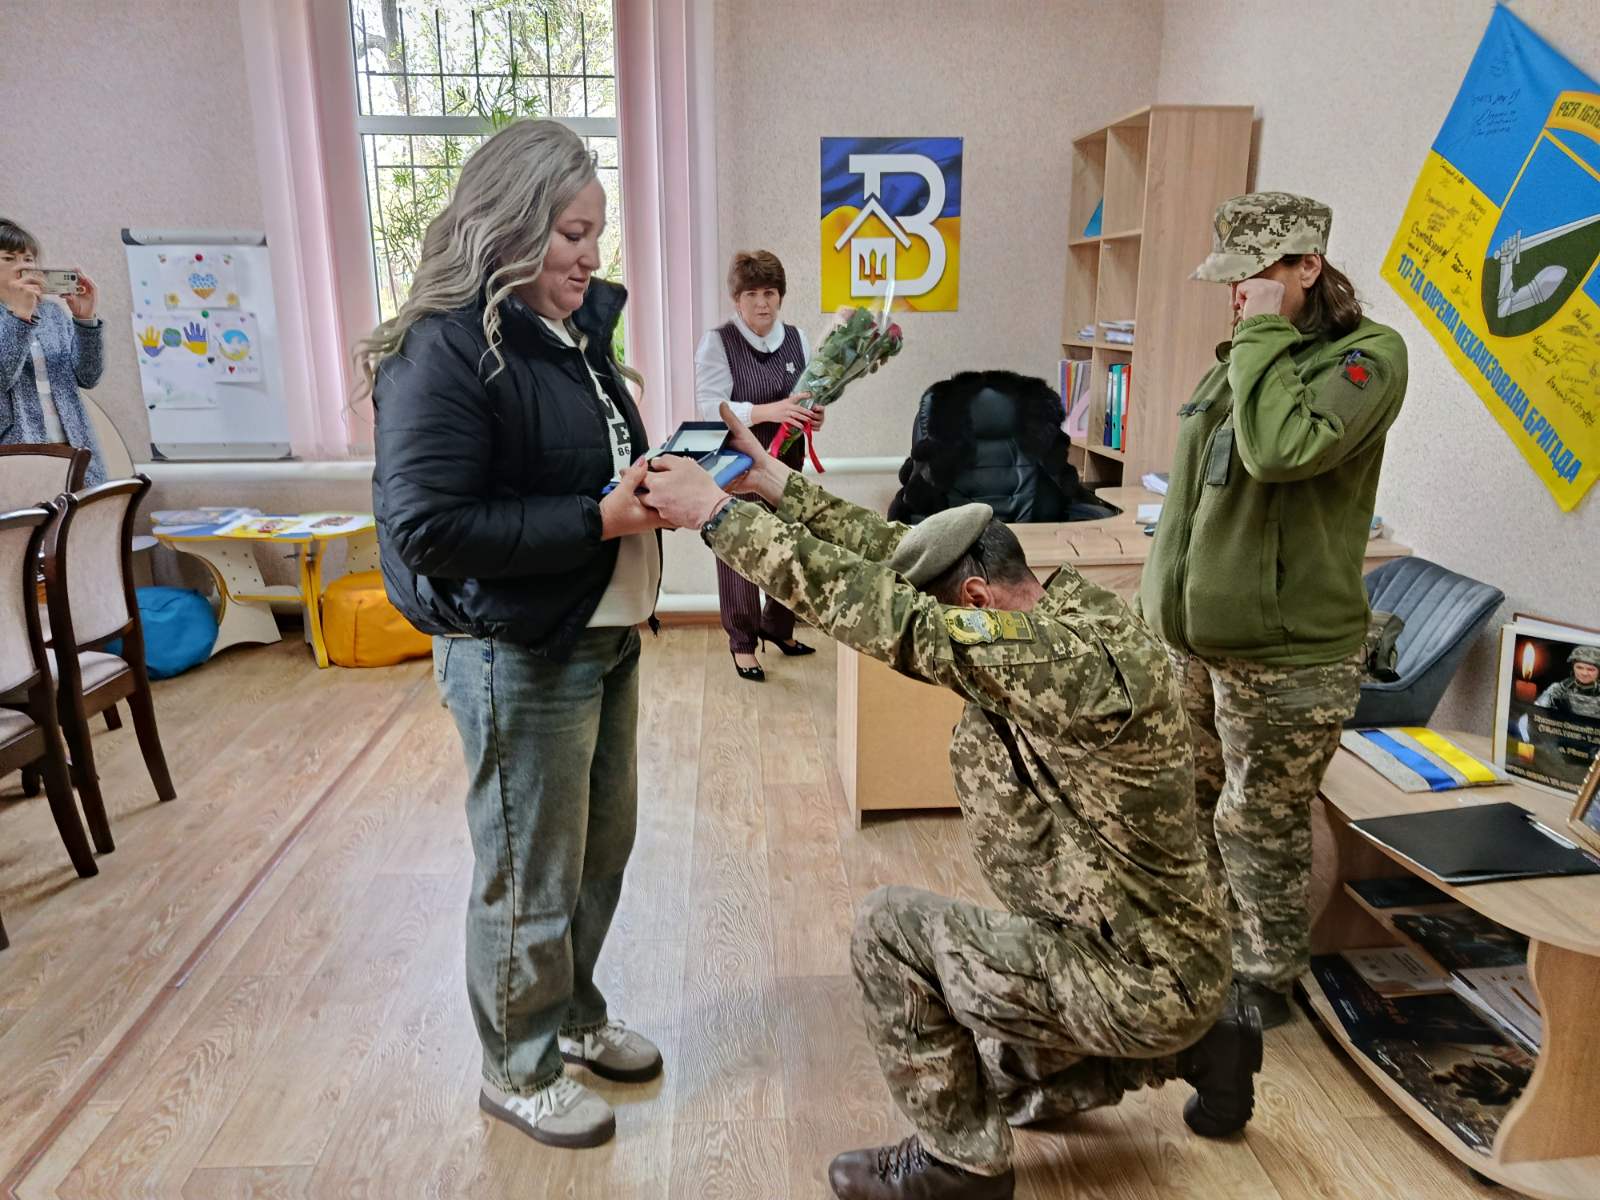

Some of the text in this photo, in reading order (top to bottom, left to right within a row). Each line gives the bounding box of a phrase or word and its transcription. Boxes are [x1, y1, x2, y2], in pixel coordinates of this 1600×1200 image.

[1556, 101, 1581, 117] PER
[1422, 280, 1460, 335] ОКРЕМА
[1454, 319, 1530, 421] МЕХАНІЗОВАНА
[1522, 407, 1583, 484] БРИГАДА
